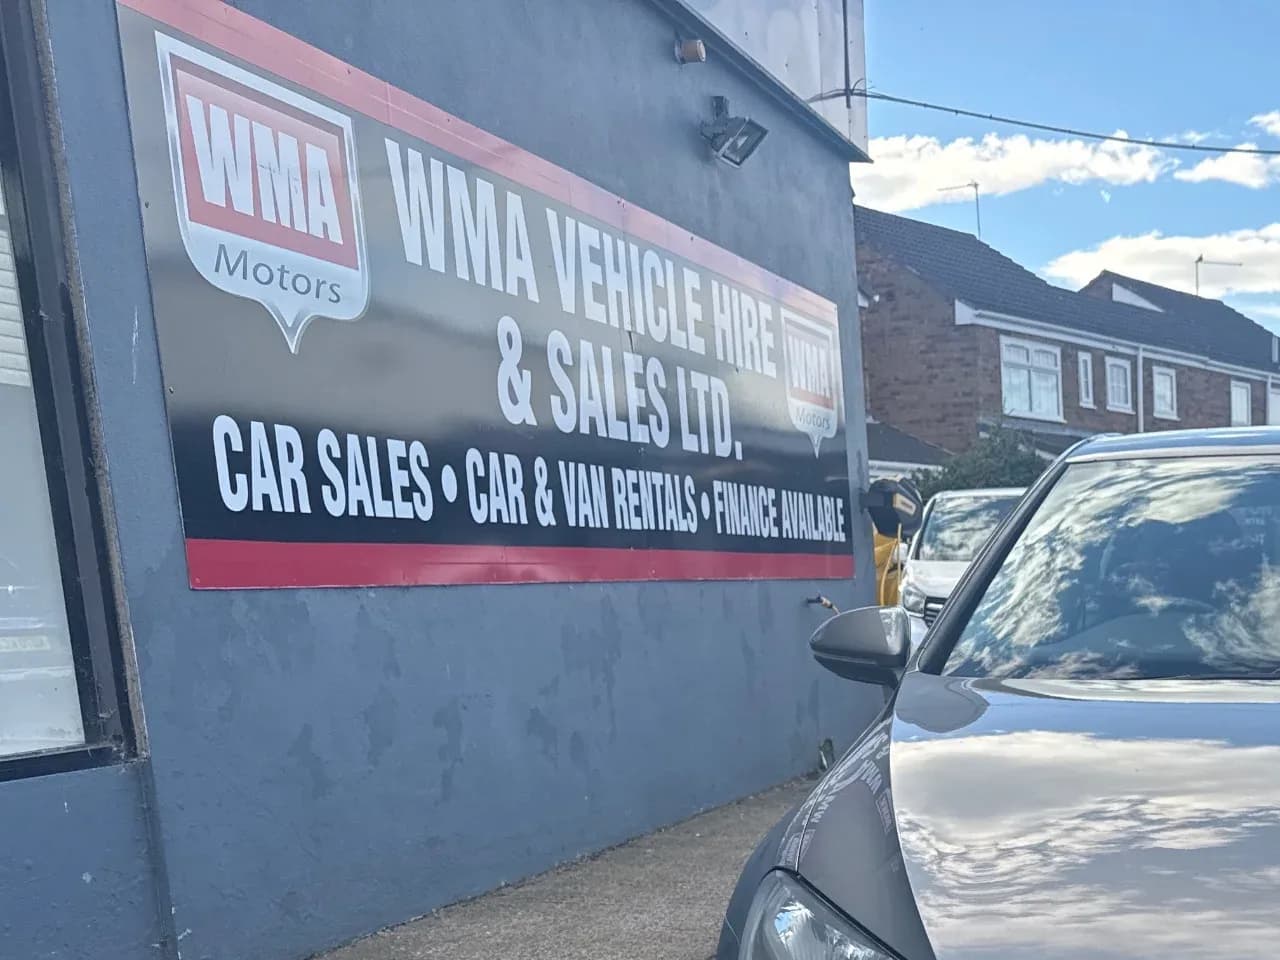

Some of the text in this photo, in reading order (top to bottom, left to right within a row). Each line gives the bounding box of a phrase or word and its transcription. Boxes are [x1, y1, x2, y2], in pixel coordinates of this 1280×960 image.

[186, 94, 344, 245] WMA
[214, 244, 341, 304] Motors
[384, 137, 777, 379] WMA VEHICLE HIRE
[497, 316, 744, 461] & SALES LTD.
[788, 335, 831, 399] WMA
[796, 407, 831, 430] Motors
[213, 414, 847, 542] CAR SALES CAR & VAN RENTALS FINANCE AVAILABLE
